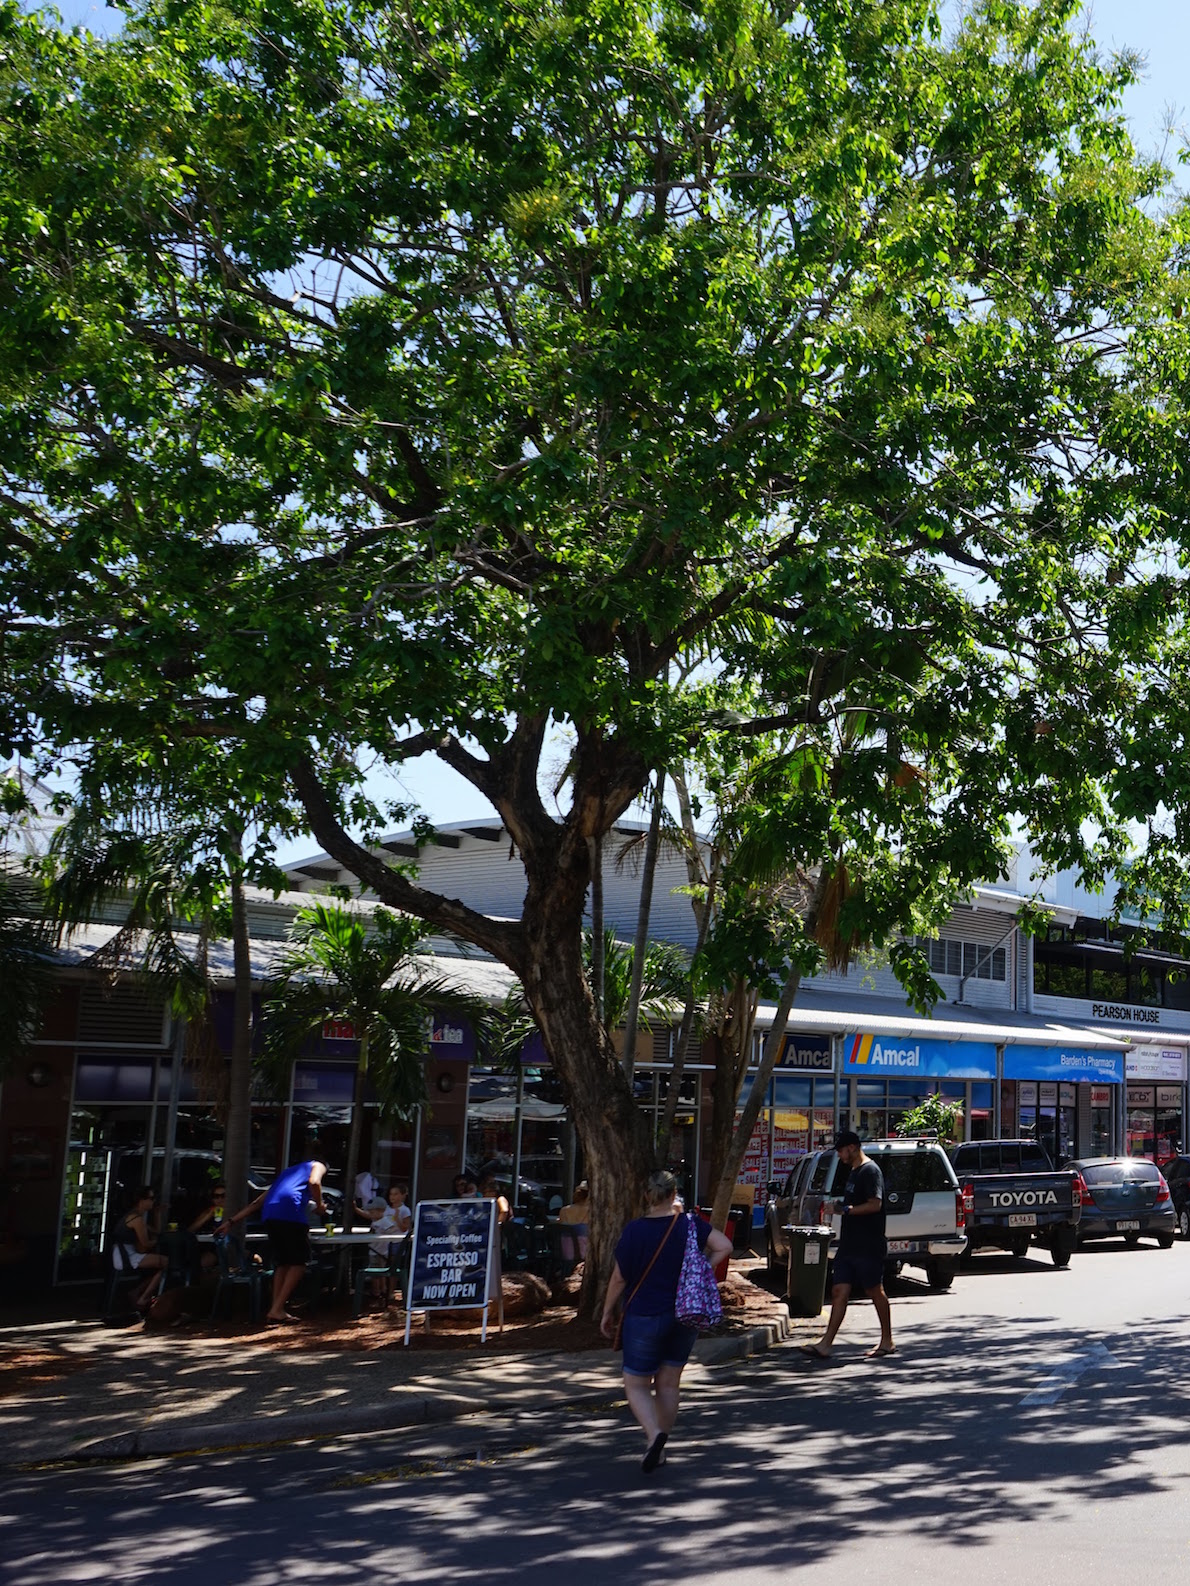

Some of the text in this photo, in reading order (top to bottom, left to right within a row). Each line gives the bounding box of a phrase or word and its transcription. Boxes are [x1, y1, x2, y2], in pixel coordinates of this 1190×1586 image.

[1092, 1004, 1160, 1023] PEARSON HOUSE
[443, 1024, 463, 1042] tea
[784, 1043, 831, 1067] Amca
[871, 1043, 920, 1067] Amcal
[1061, 1054, 1116, 1070] Barden's Pharmacy
[745, 1174, 759, 1185] SALE
[989, 1191, 1058, 1207] TOYOTA
[460, 1233, 483, 1243] Coffee
[426, 1251, 479, 1268] ESPRESSO
[440, 1268, 462, 1283] BAR
[422, 1283, 477, 1299] NOW OPEN
